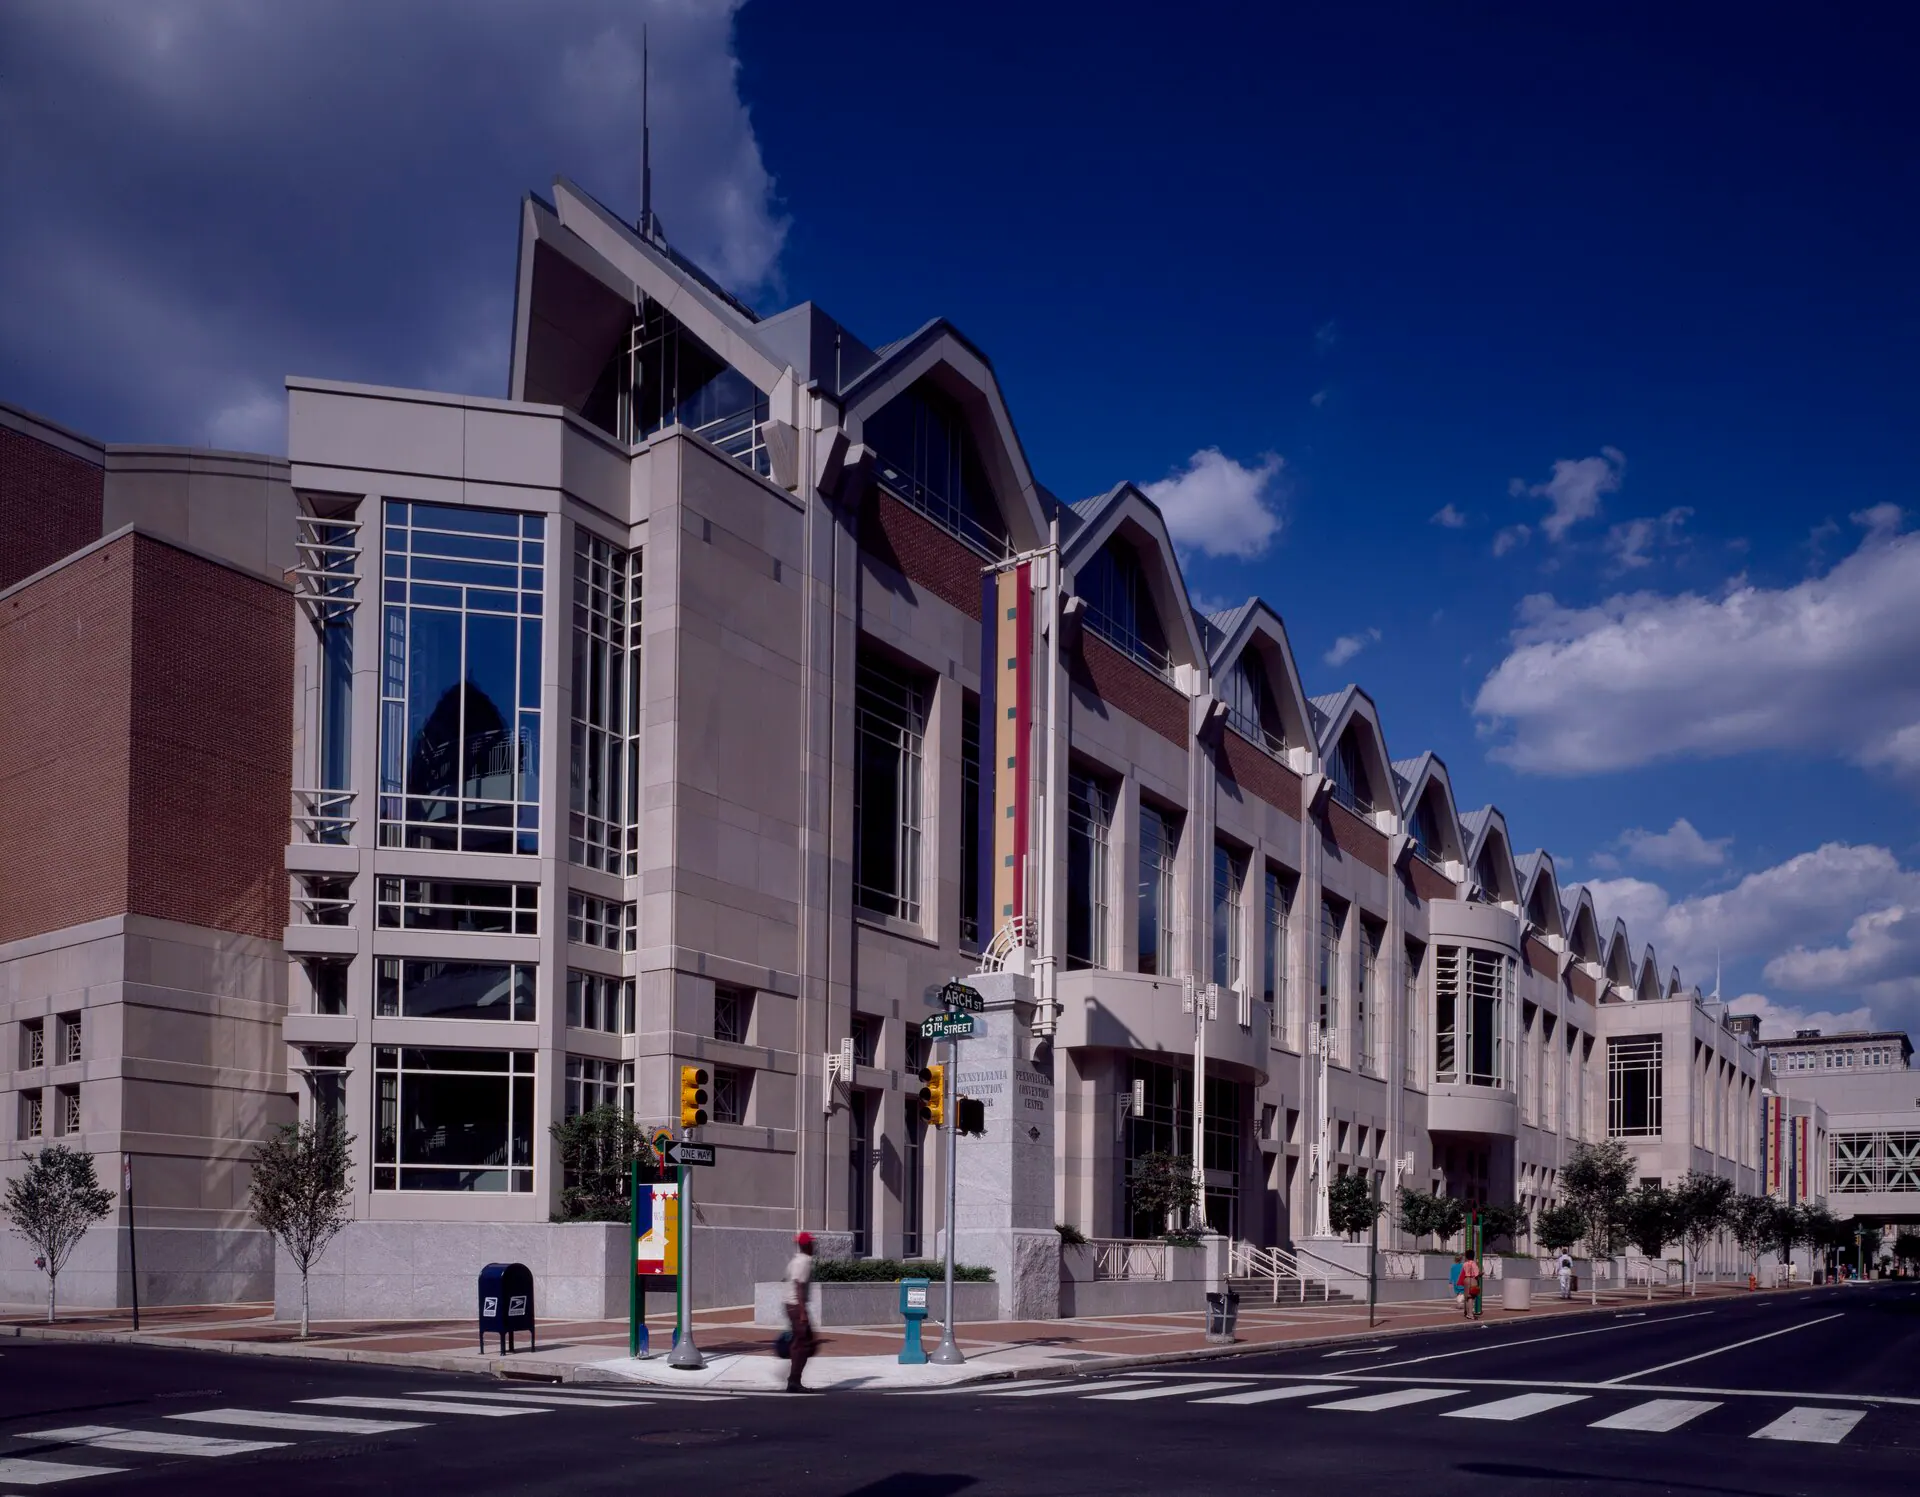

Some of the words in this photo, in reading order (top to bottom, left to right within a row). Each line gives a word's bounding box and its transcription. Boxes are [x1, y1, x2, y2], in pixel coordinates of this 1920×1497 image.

[945, 990, 972, 1008] ARCH
[974, 1001, 982, 1010] ST
[944, 1014, 949, 1022] N
[921, 1022, 943, 1037] 13TH
[943, 1022, 972, 1035] STREET
[957, 1070, 1008, 1083] ENNSYLVANIA
[1024, 1098, 1044, 1110] CENTER
[680, 1149, 696, 1160] ONE
[697, 1150, 711, 1161] WAY
